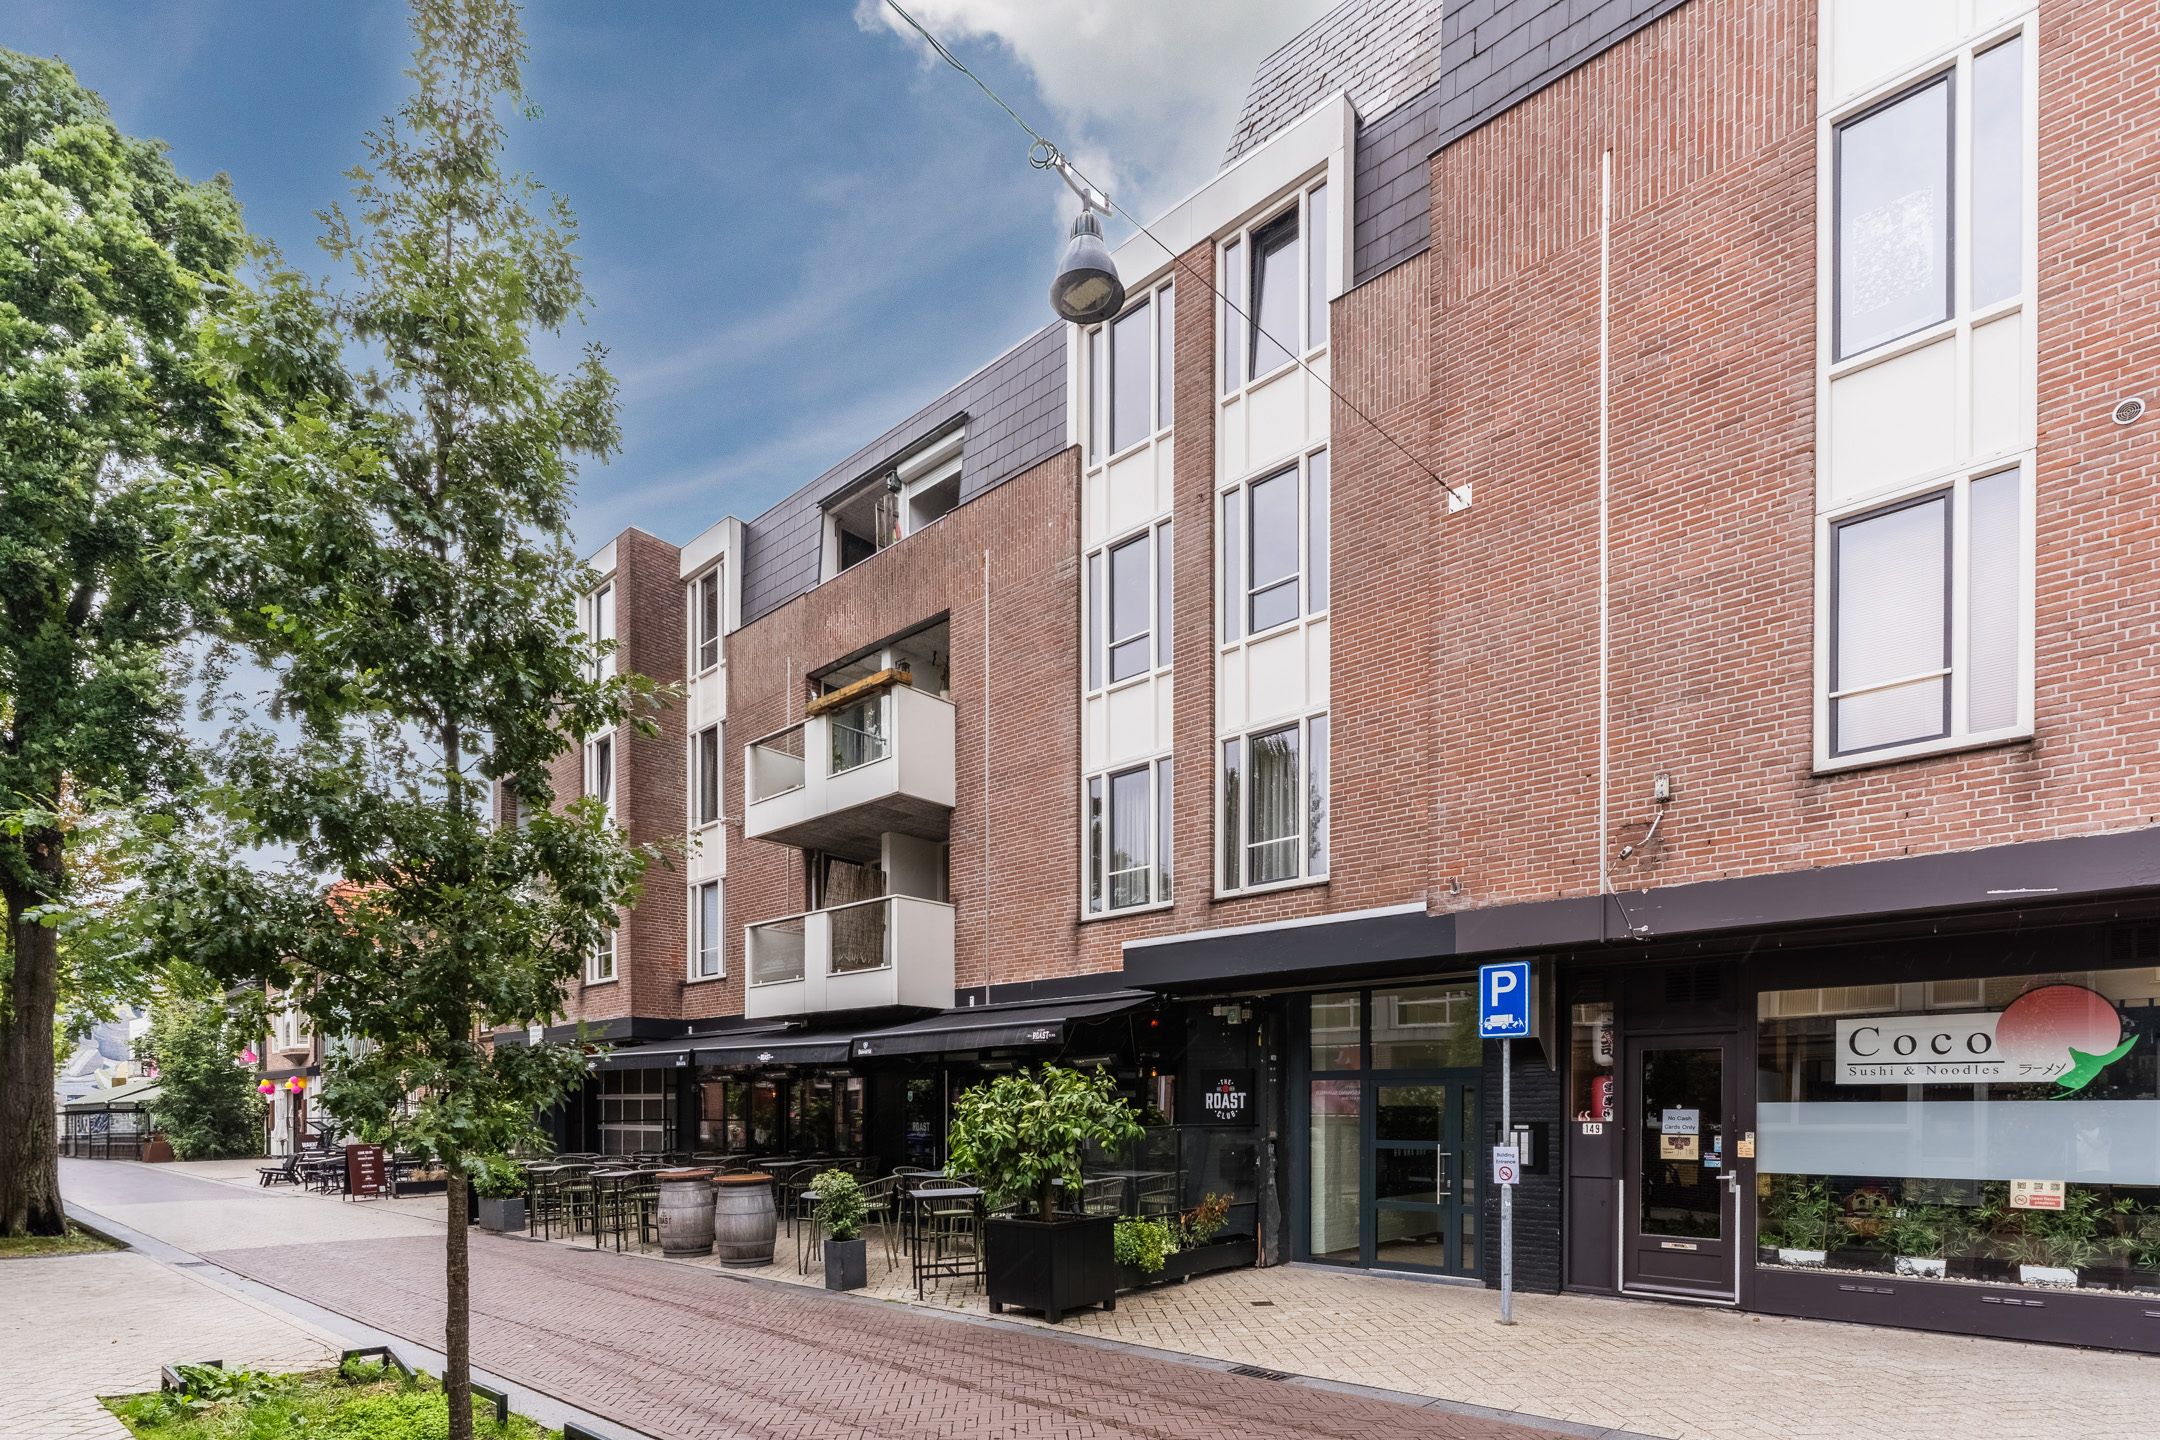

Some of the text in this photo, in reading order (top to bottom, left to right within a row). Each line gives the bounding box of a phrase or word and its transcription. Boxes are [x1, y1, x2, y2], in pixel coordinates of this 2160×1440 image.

[1491, 970, 1517, 1007] P
[1849, 1026, 1992, 1057] Coco
[1849, 1065, 2000, 1076] Sushi & Noodles
[1205, 1092, 1246, 1109] ROAST
[1216, 1110, 1236, 1120] CLUB
[912, 1121, 930, 1132] ROAST
[1585, 1124, 1600, 1134] 149
